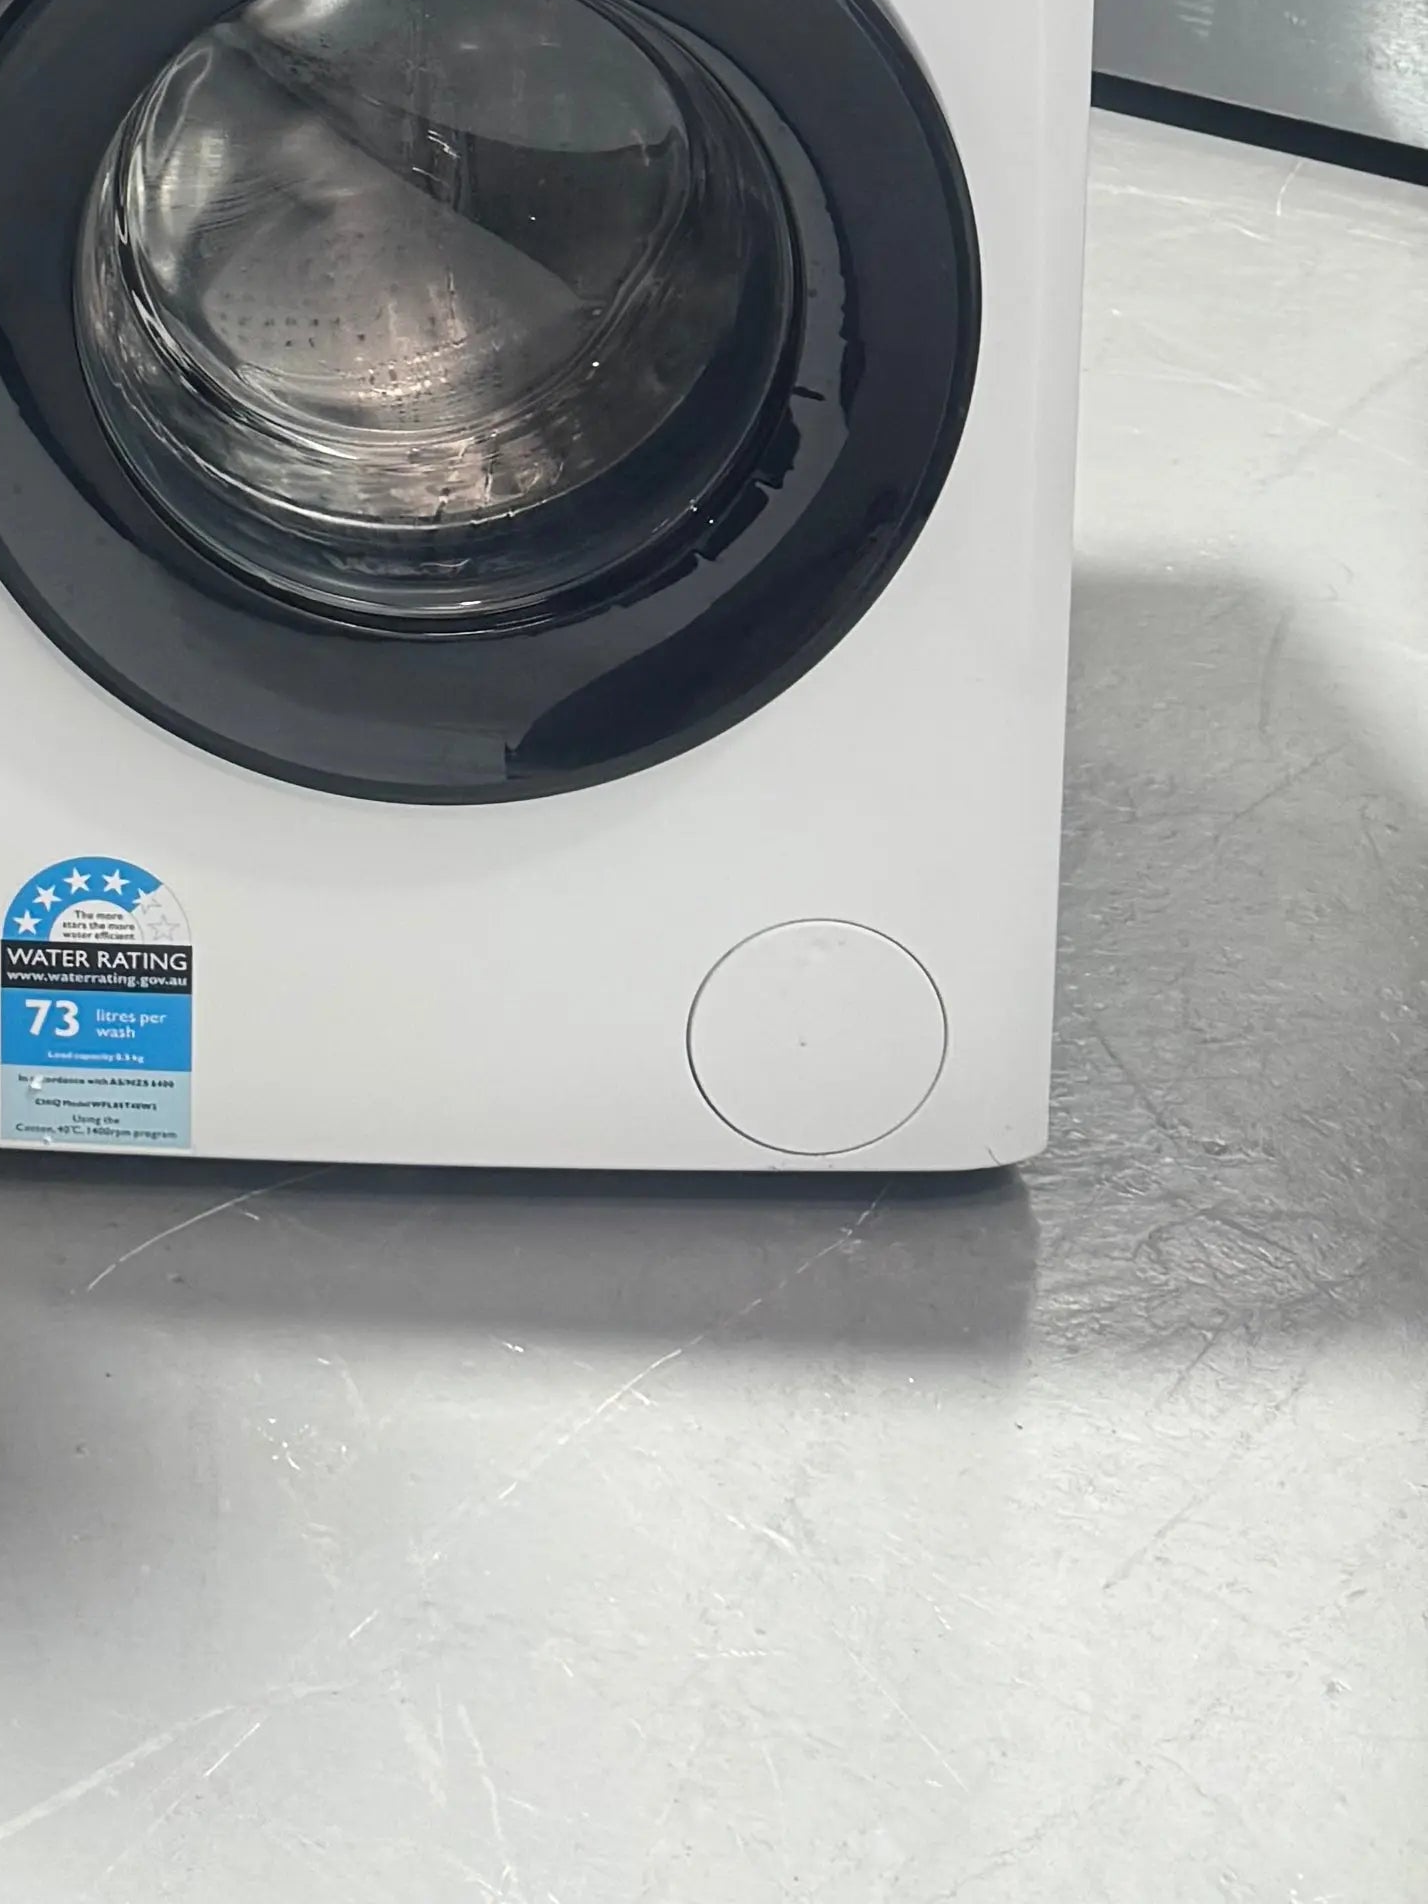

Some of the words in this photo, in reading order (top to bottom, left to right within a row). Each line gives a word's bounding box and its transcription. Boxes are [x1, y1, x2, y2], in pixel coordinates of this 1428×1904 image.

[75, 910, 94, 920] The
[96, 912, 123, 920] more
[88, 922, 106, 930] the
[108, 923, 135, 931] more
[7, 947, 90, 968] WATER
[97, 950, 187, 971] RATING
[7, 971, 187, 988] www.waterrating.gov.au
[25, 998, 80, 1037] 73
[96, 1008, 136, 1024] litres
[140, 1012, 167, 1027] per
[96, 1025, 136, 1039] wash
